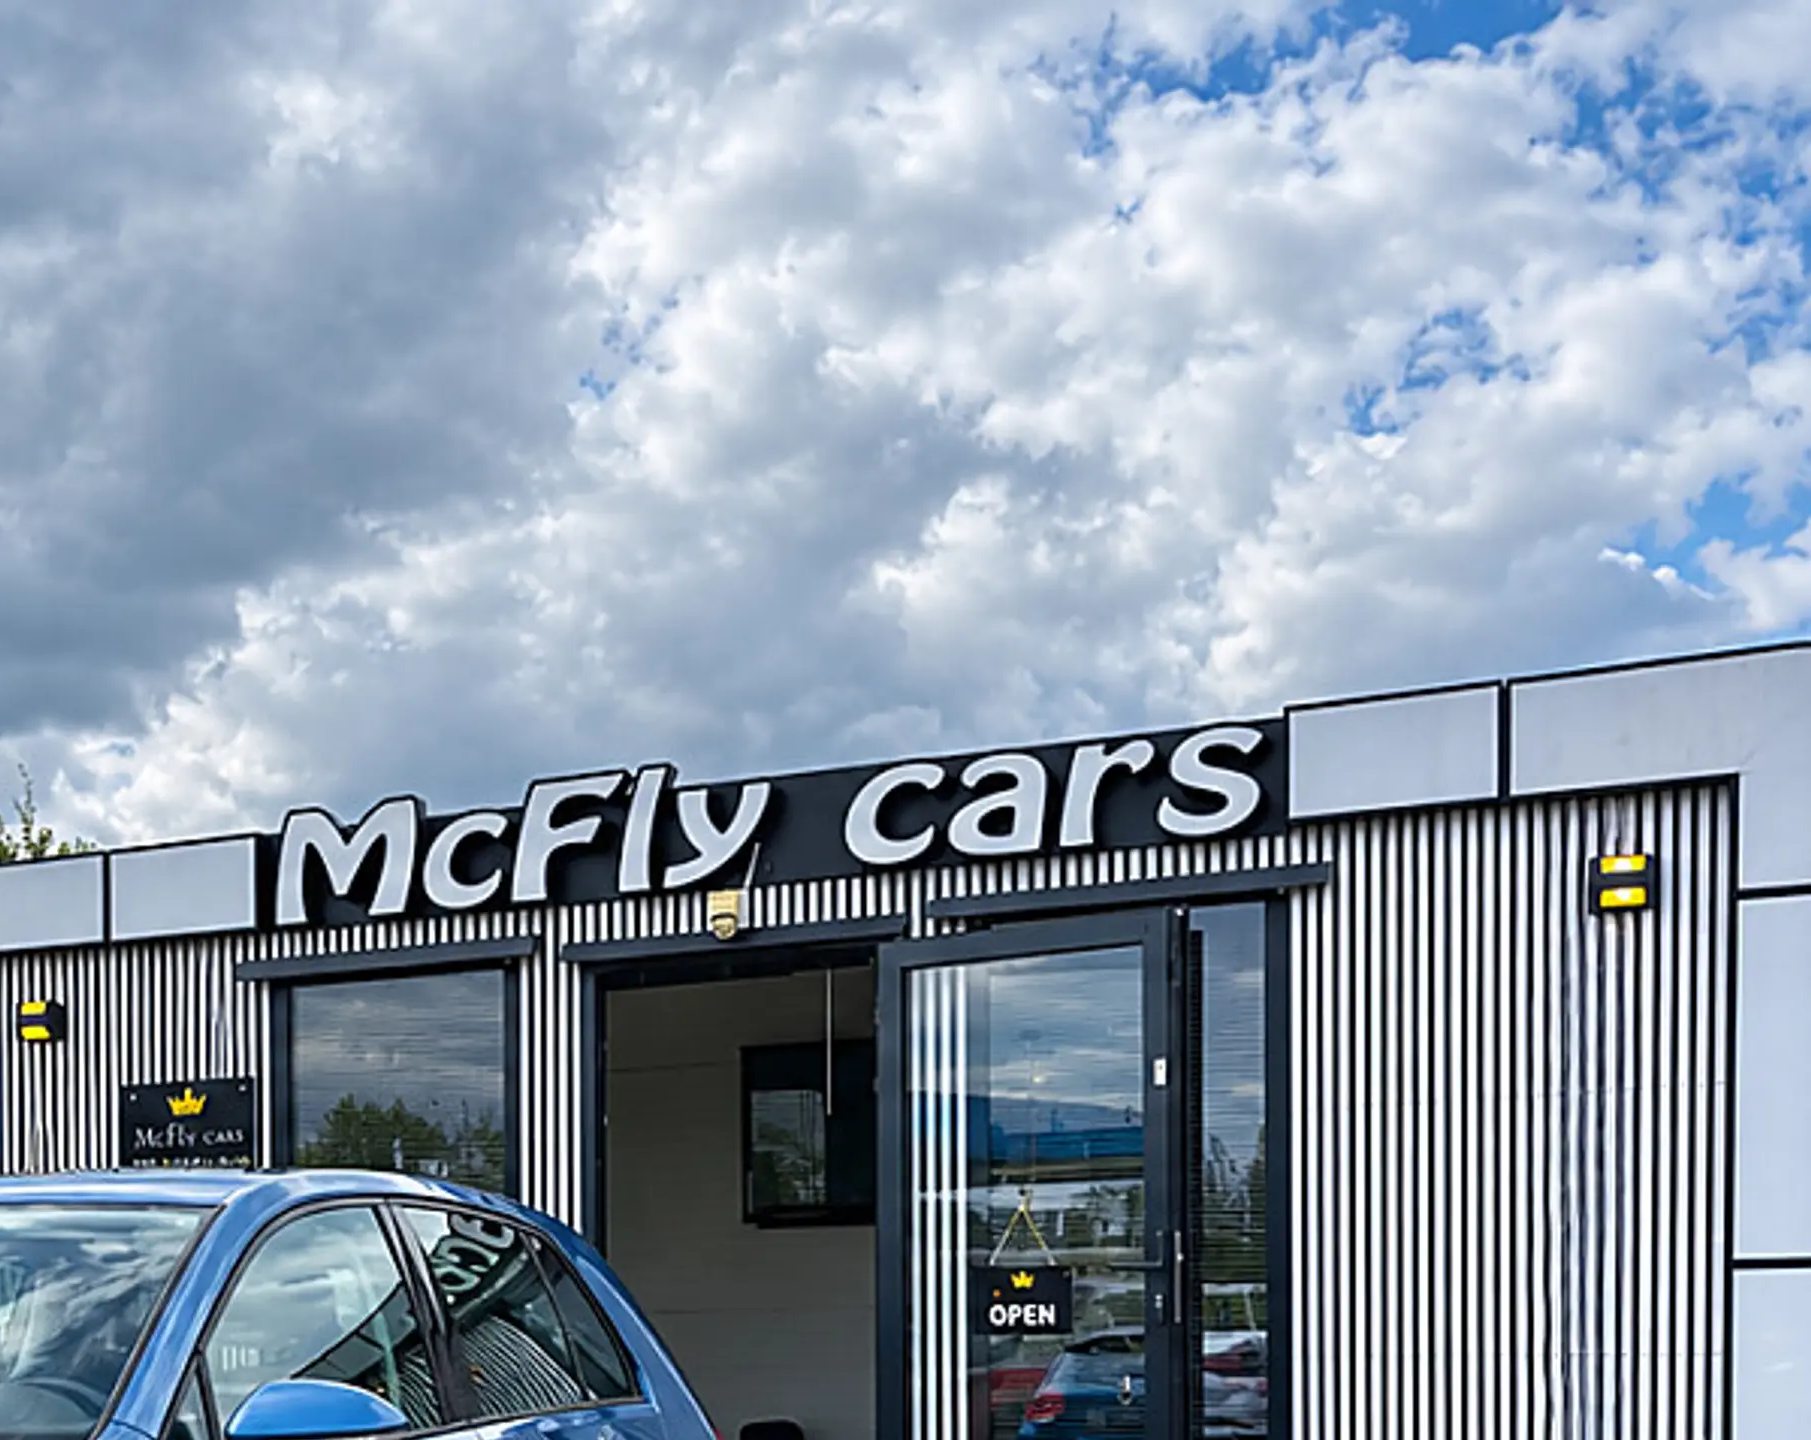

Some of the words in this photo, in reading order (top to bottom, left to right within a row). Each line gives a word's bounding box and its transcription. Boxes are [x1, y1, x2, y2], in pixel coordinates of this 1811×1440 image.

[275, 764, 771, 926] McFly
[844, 726, 1264, 865] cars
[989, 1304, 1055, 1327] OPEN
